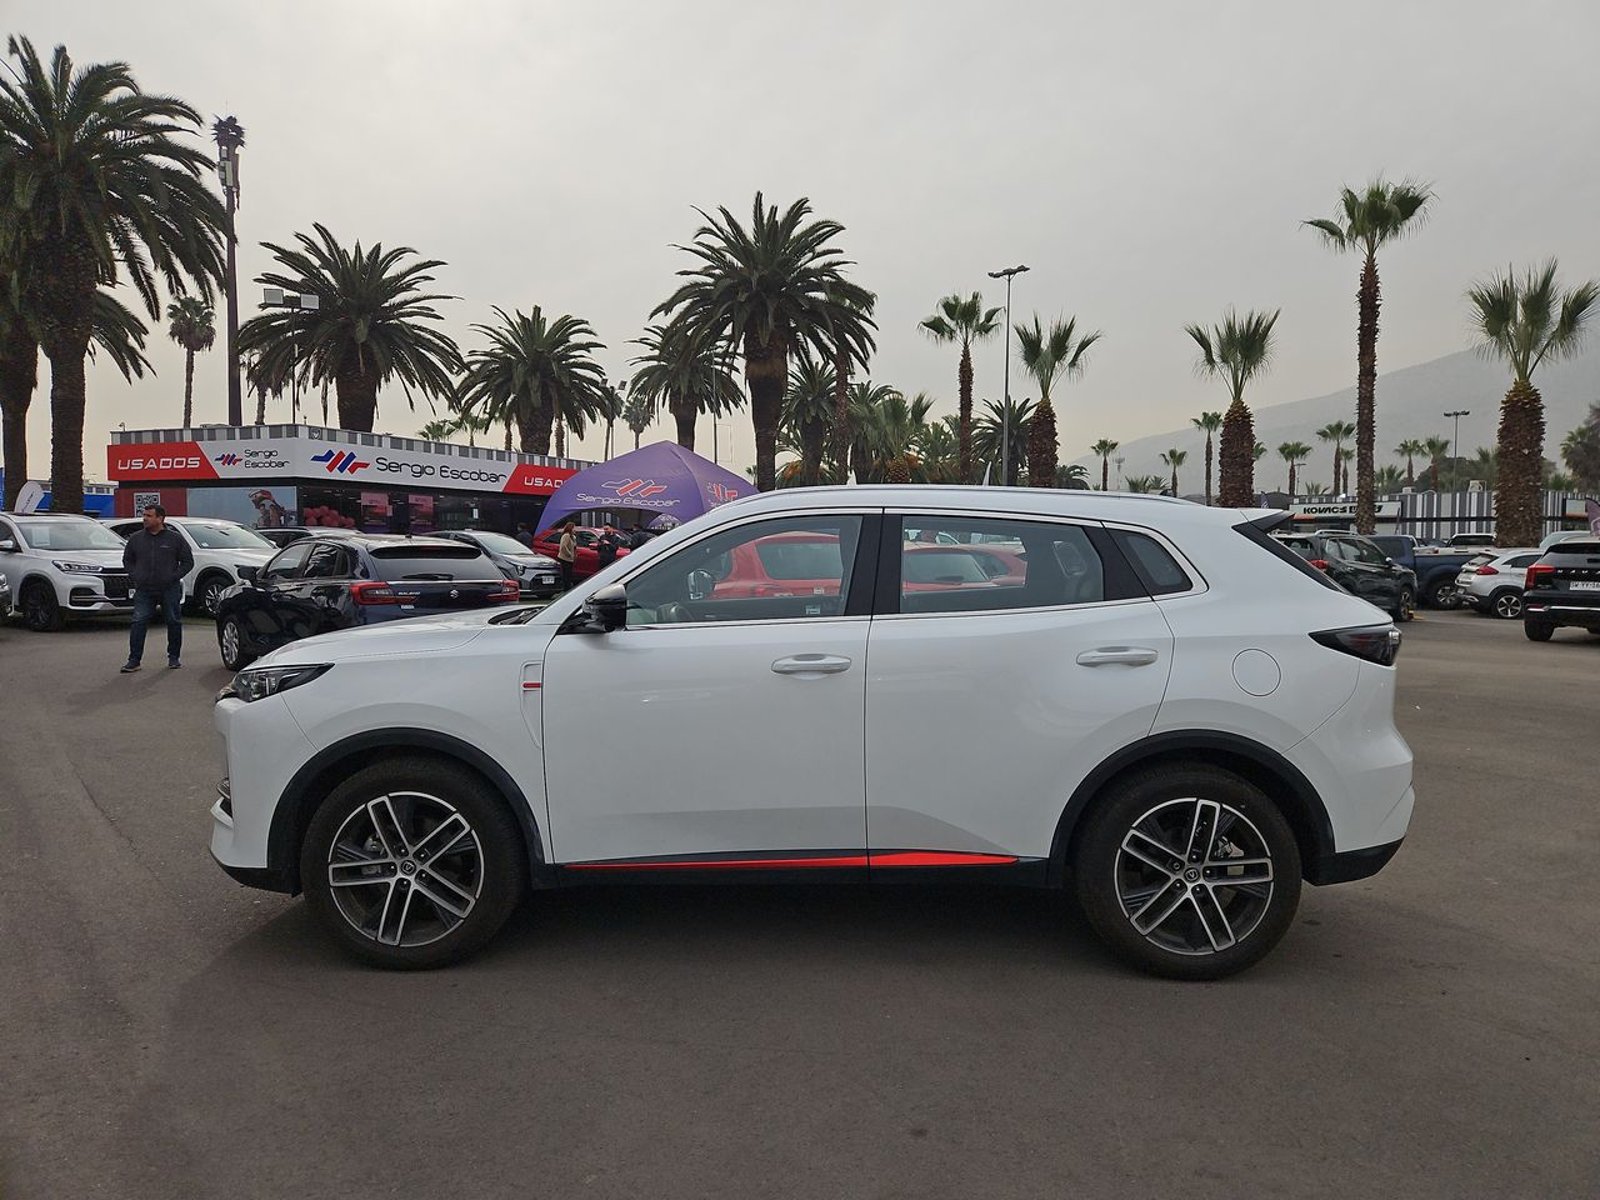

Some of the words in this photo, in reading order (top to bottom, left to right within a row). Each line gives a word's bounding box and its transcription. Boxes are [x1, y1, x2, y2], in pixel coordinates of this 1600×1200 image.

[244, 449, 279, 461] Sergio
[117, 457, 201, 470] USADOS
[244, 459, 290, 469] Escobar
[375, 456, 436, 478] Sergio
[439, 464, 507, 484] Escobar
[524, 476, 565, 488] USAD
[576, 493, 621, 507] Sergio
[622, 496, 681, 509] Escobar
[1303, 506, 1347, 514] KOVACS
